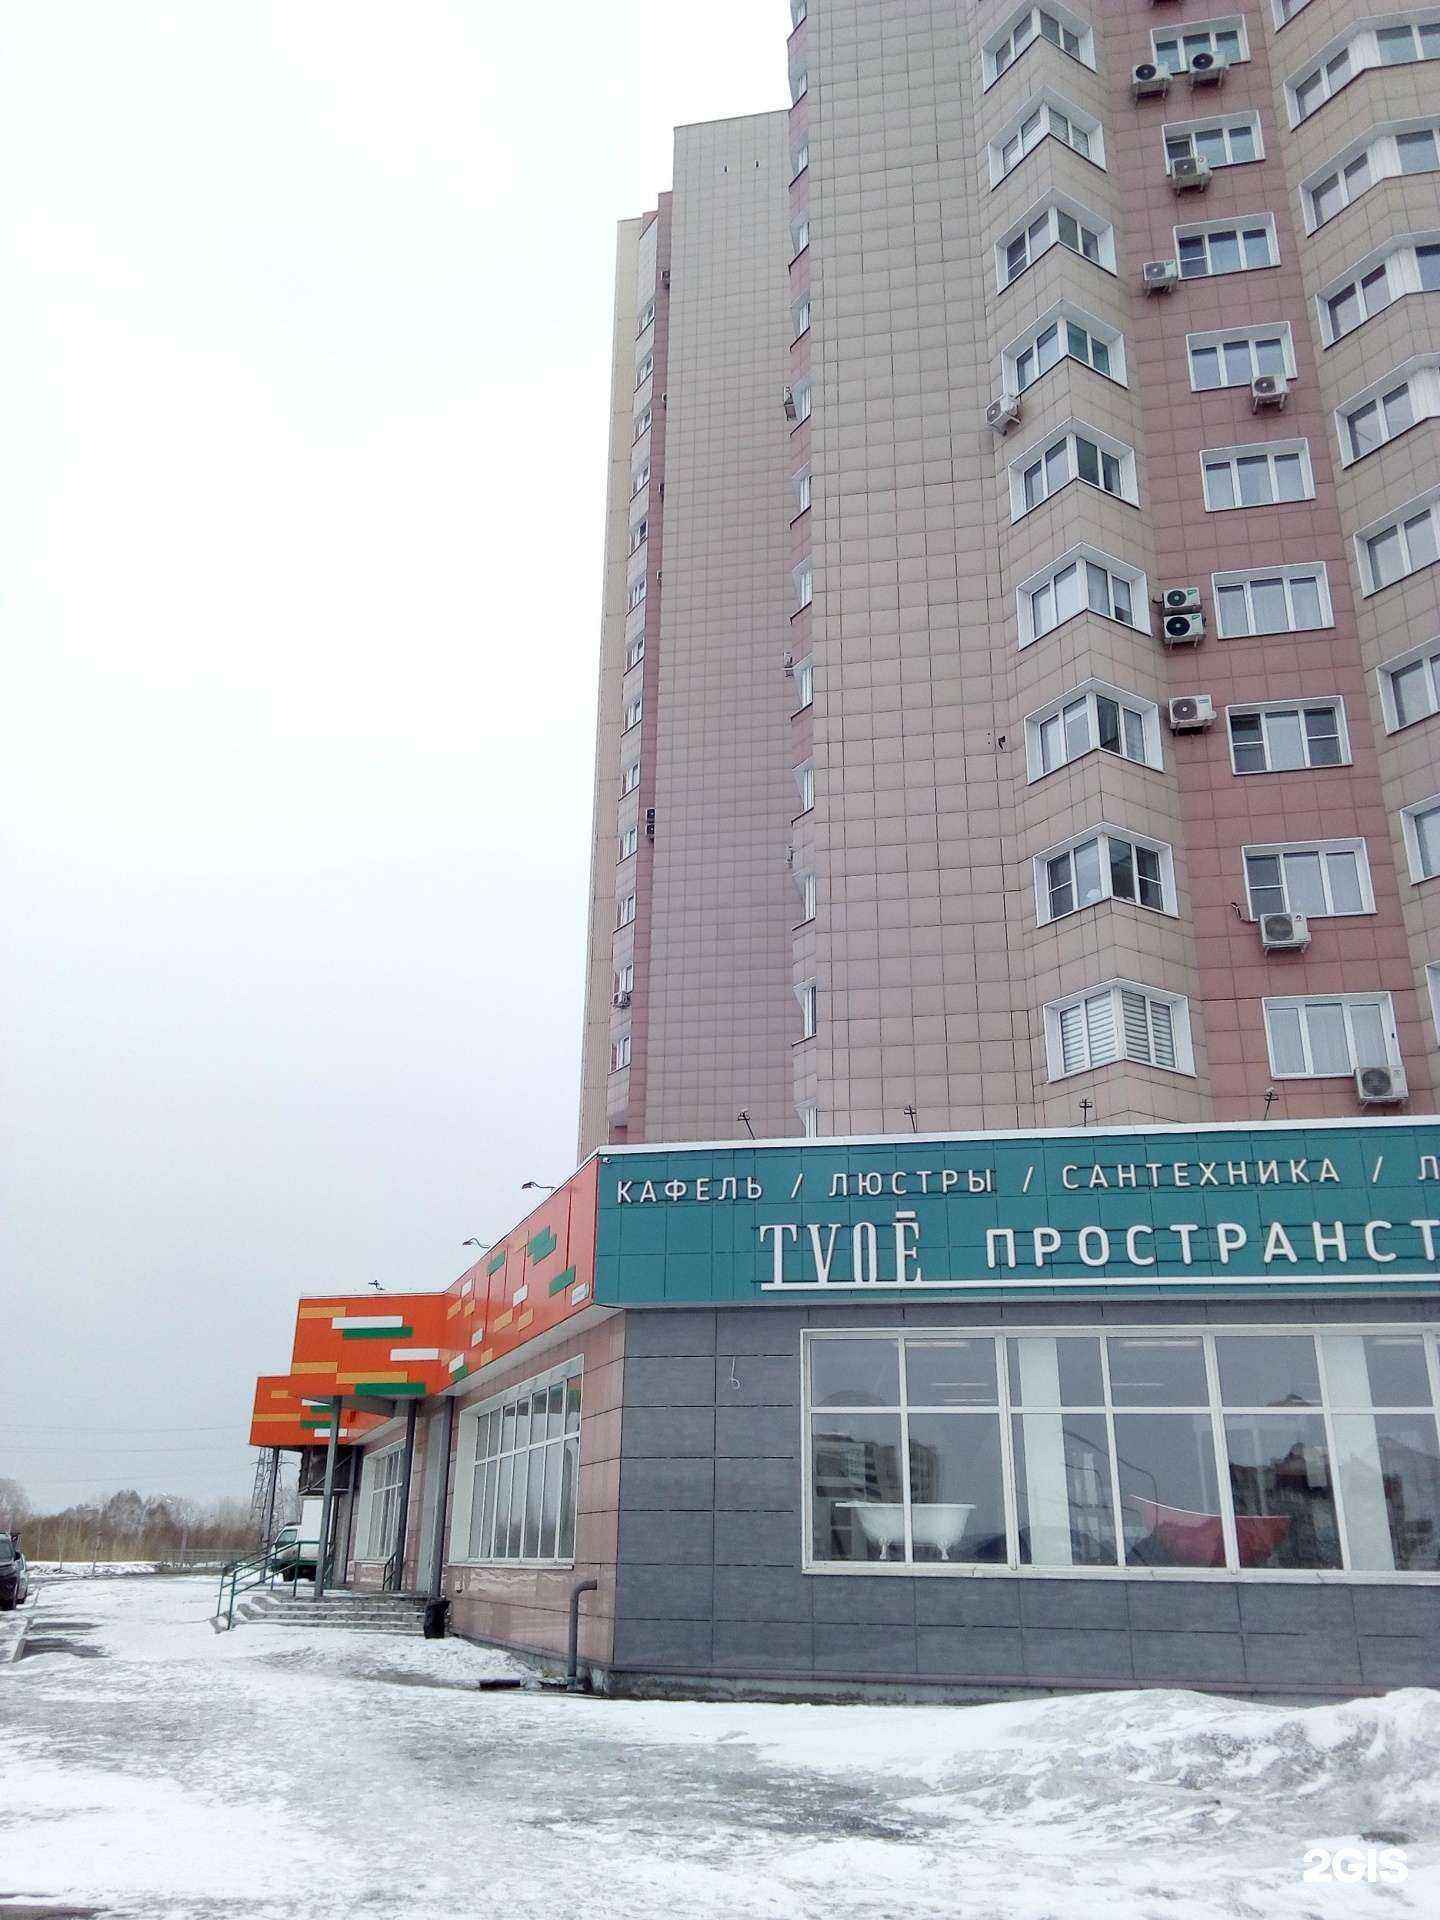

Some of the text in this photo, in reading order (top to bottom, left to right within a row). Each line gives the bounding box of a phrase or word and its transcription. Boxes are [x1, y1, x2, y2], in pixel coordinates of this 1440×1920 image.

[617, 1176, 763, 1204] КАФЕЛЬ
[829, 1170, 992, 1196] ЛЮСТРЫ
[1062, 1158, 1340, 1189] САНТЕХНИКА
[986, 1218, 1440, 1269] ПРОСТРАНСТ
